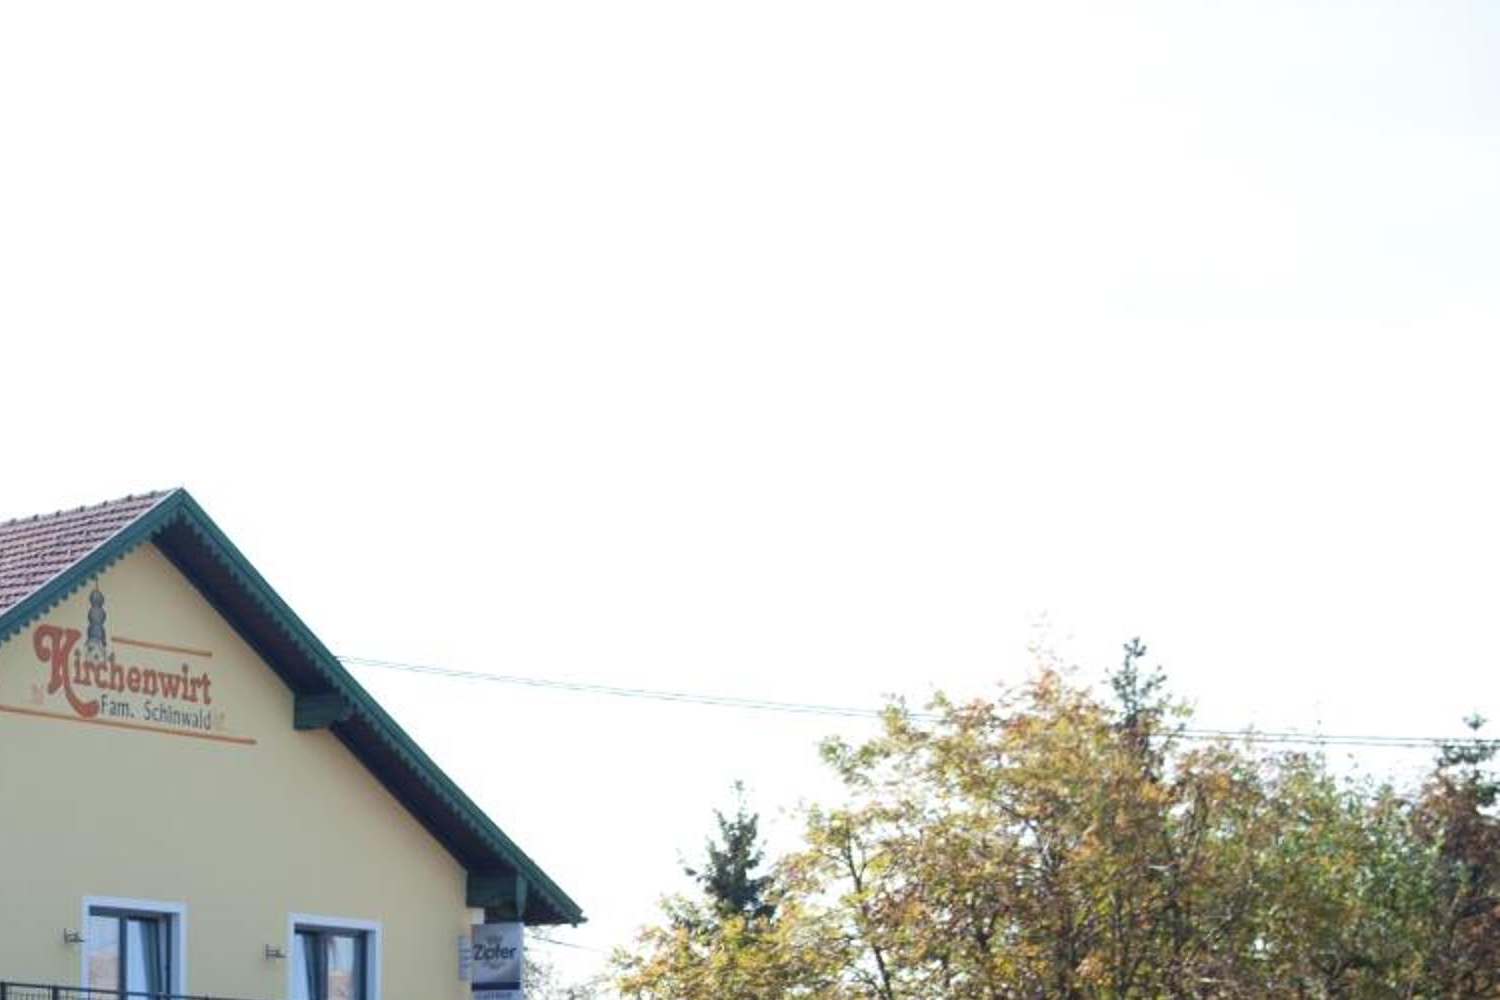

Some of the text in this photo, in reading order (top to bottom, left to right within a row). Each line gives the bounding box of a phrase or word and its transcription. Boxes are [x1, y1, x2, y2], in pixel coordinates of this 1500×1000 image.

[33, 623, 212, 718] Kirchenwirt
[100, 694, 211, 730] Fam. Schinwald
